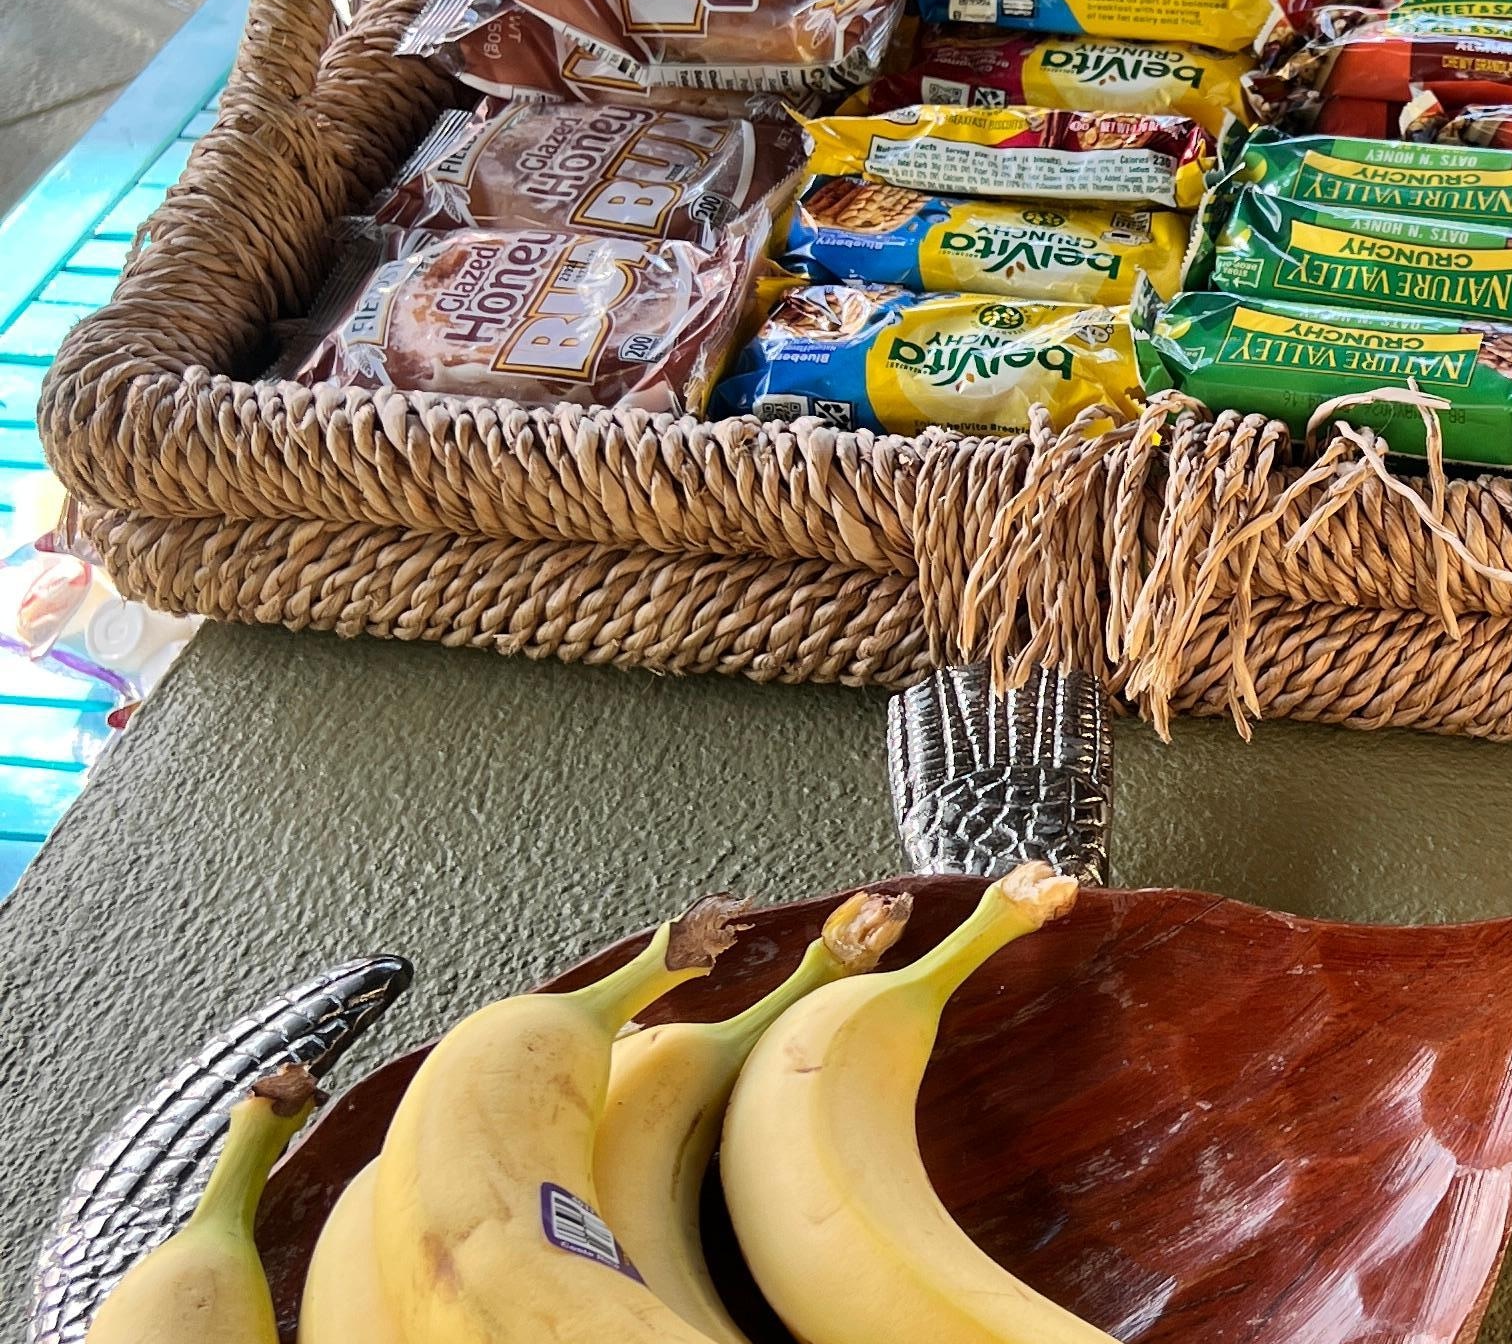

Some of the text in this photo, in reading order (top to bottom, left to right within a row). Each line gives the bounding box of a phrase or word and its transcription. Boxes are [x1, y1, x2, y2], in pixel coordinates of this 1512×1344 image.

[1160, 17, 1179, 25] and
[1073, 42, 1185, 63] CRUNCHY
[1441, 56, 1474, 69] CHEWY
[1039, 48, 1205, 89] belVita
[519, 115, 583, 174] Glazed
[525, 105, 658, 201] Honey
[1365, 148, 1414, 165] HONEY
[1440, 154, 1478, 168] OATS
[1303, 172, 1402, 206] VALLEY
[1352, 167, 1481, 186] CRUNCHY
[975, 226, 1098, 249] CRUNCHY
[1351, 218, 1402, 236] HONEY
[1430, 228, 1471, 245] OATS
[941, 231, 1122, 280] belVita
[1338, 237, 1474, 269] CRUNCHY
[435, 245, 501, 314] Glazed
[444, 232, 568, 343] Honey
[1287, 253, 1392, 295] VALLEY
[627, 335, 653, 358] 200
[1284, 322, 1425, 351] CRUNCHY
[887, 337, 1075, 386] belVita
[1228, 332, 1467, 381] NATURE VALLEY
